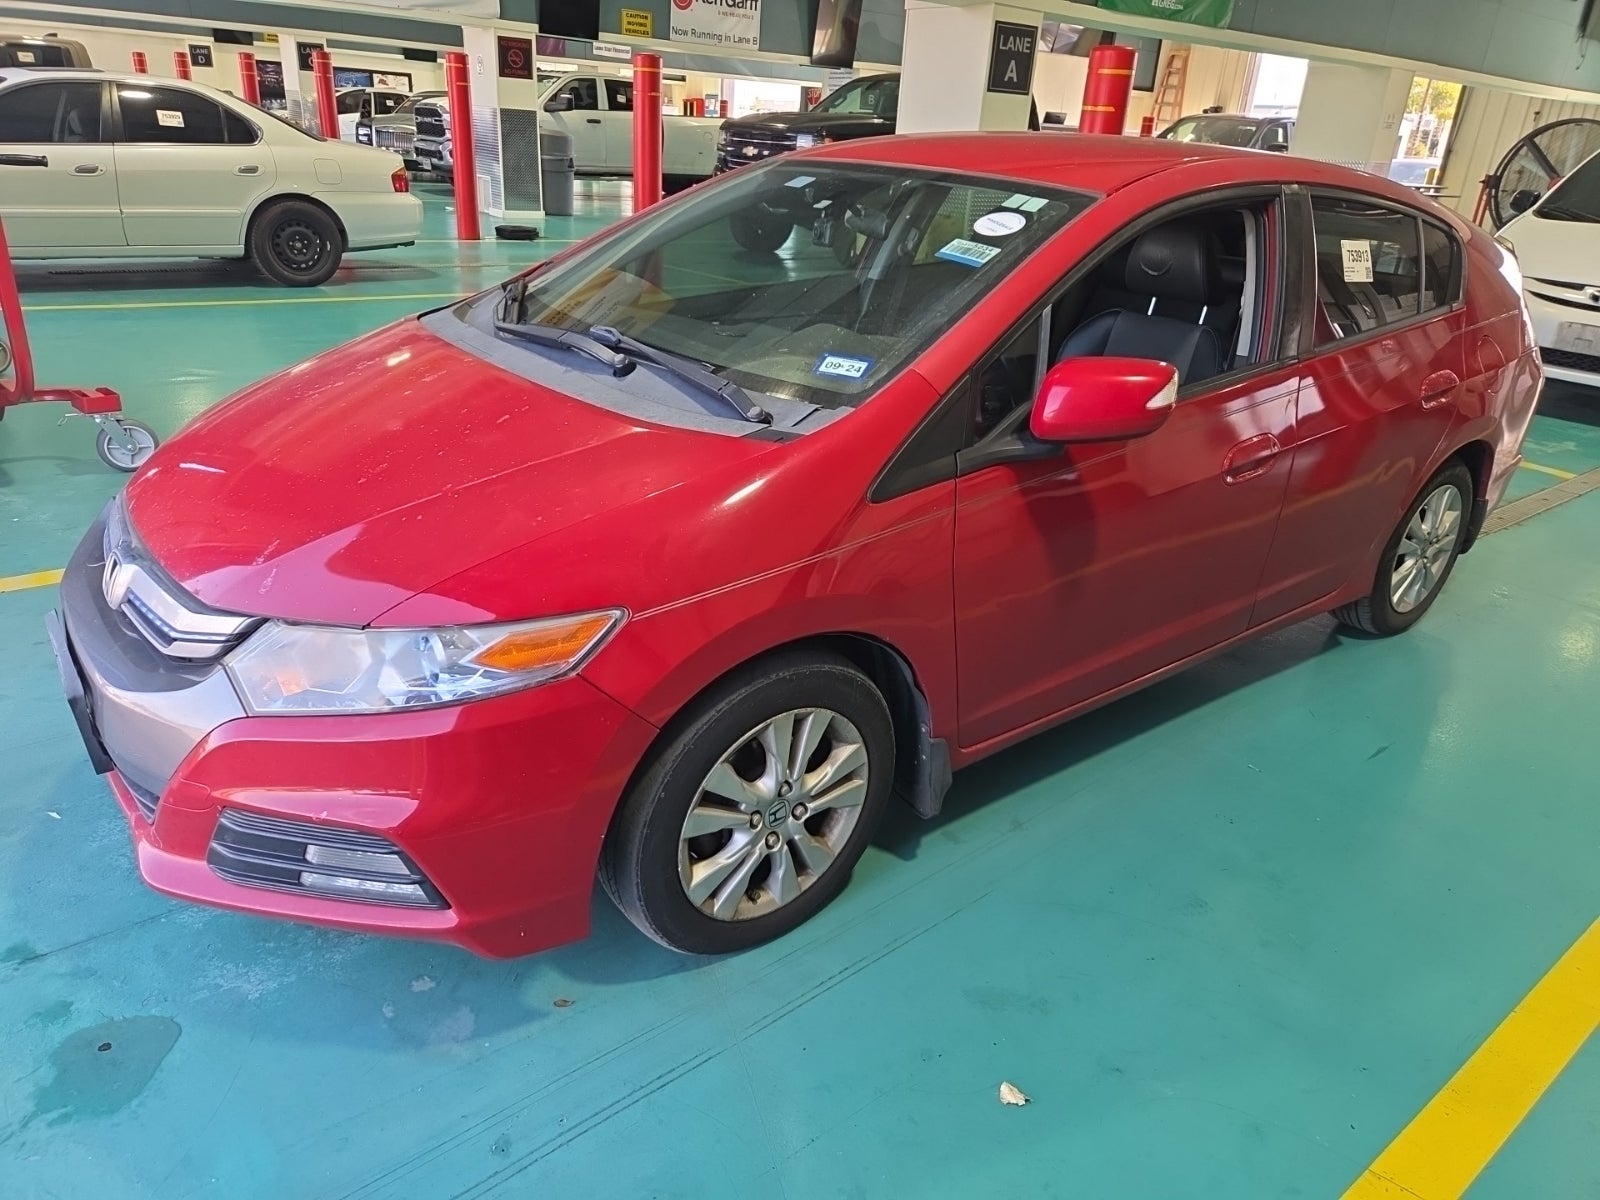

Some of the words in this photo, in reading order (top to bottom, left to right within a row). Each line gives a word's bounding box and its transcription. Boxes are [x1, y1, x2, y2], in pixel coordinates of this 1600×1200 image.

[625, 12, 649, 20] CAUTION
[626, 20, 648, 28] MOVING
[624, 27, 650, 36] VEHICLES
[671, 26, 689, 37] Now
[690, 28, 723, 44] Running
[724, 32, 731, 42] in
[733, 34, 751, 45] Lane
[752, 36, 758, 46] B
[999, 34, 1032, 53] LANE
[191, 47, 209, 55] LANE
[198, 55, 206, 64] D
[1003, 59, 1018, 83] A
[808, 88, 821, 98] STOP
[867, 94, 876, 105] B
[1346, 249, 1370, 263] 753913
[824, 361, 841, 370] 09
[844, 364, 863, 374] 24
